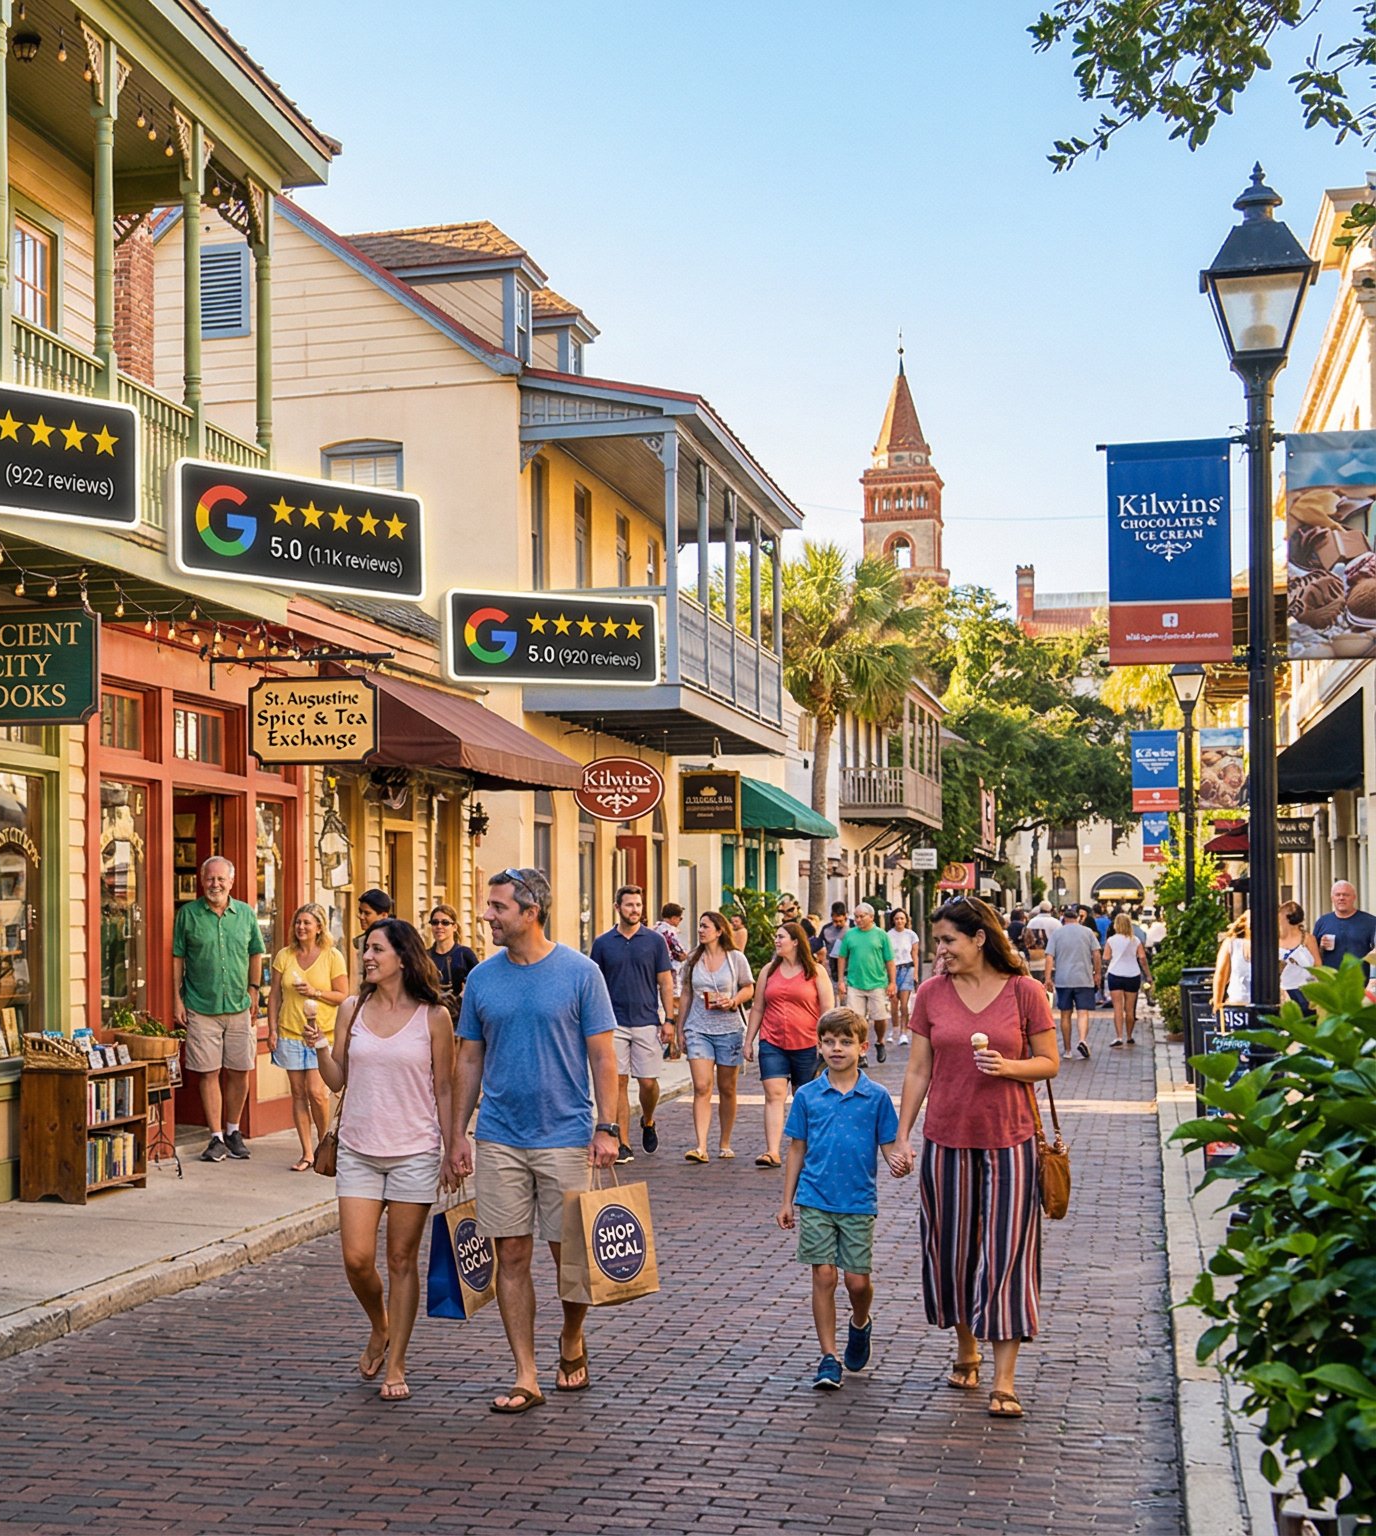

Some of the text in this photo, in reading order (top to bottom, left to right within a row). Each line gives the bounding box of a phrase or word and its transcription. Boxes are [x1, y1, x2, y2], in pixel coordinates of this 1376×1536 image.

[5, 463, 44, 487] (922
[48, 473, 114, 500] reviews)
[1117, 492, 1222, 517] Kilwins
[1121, 516, 1217, 529] CHOCOLATES &
[1135, 531, 1156, 541] ICE
[270, 537, 302, 560] 5.0
[346, 554, 403, 578] reviews)
[528, 645, 641, 669] 5.0 (920 reviews)
[265, 690, 359, 709] St. Augustine
[257, 708, 367, 730] Spice & Tea
[267, 729, 357, 750] Exchange
[598, 1222, 635, 1243] SHOP
[458, 1236, 485, 1258] SHOP
[599, 1240, 642, 1261] LOCAL
[461, 1249, 492, 1275] LOCAL
